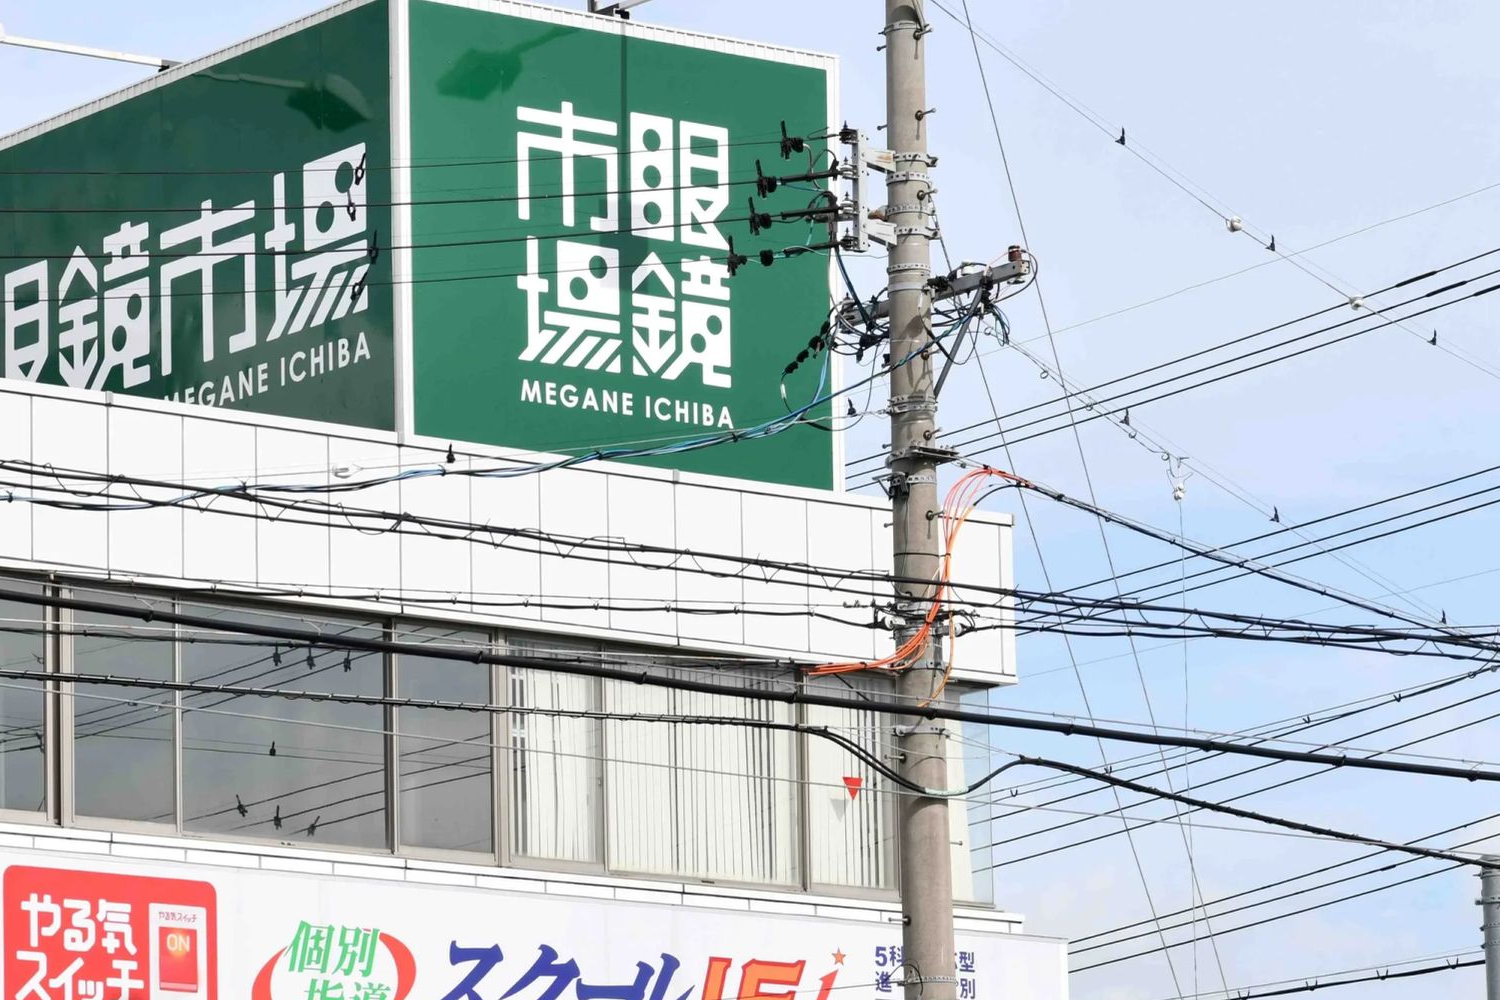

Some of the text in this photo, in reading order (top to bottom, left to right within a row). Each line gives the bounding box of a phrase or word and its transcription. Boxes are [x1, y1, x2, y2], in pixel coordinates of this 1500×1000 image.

[279, 331, 371, 386] ICHIBA
[520, 379, 734, 429] MEGANE ICHIBA
[20, 892, 137, 955] やる気
[158, 911, 197, 923] やる気スイッチ
[166, 933, 191, 952] ON
[284, 920, 380, 977] 個別
